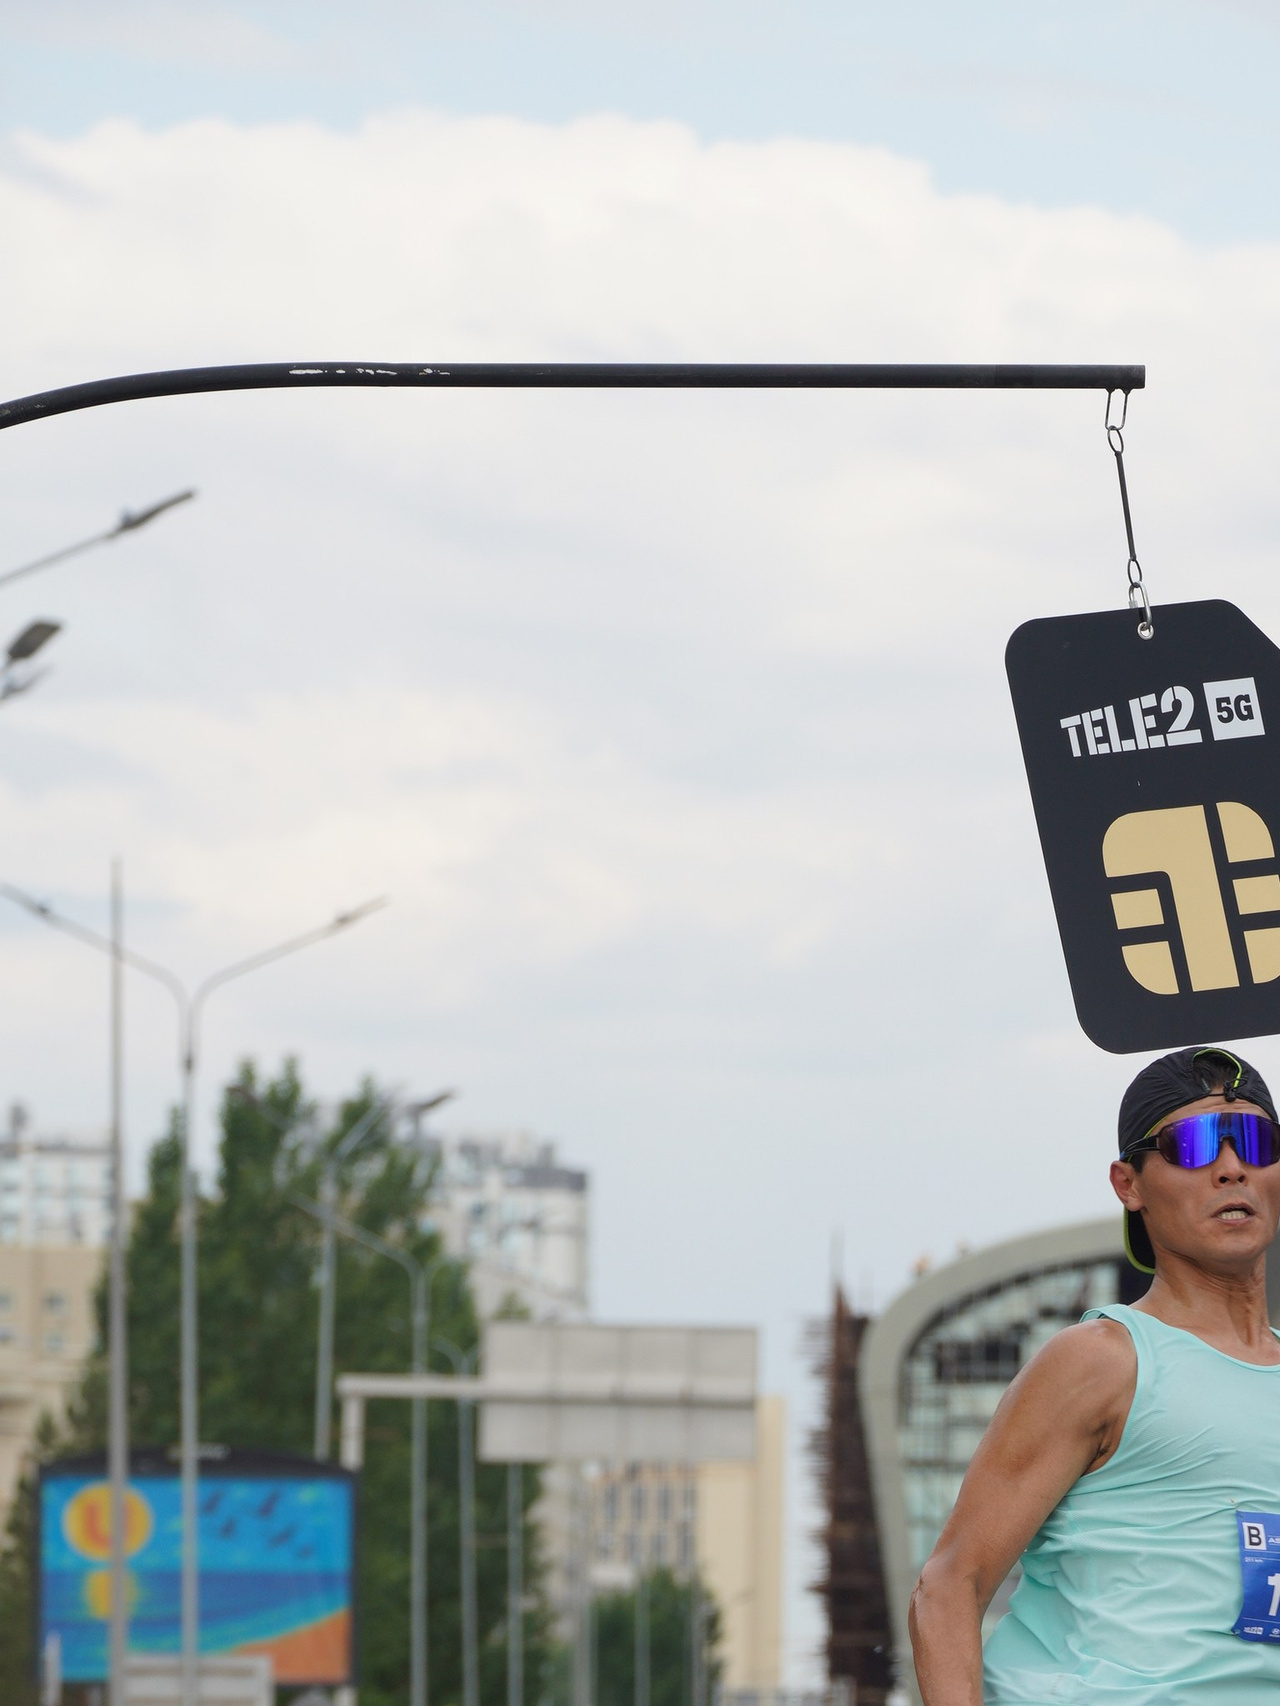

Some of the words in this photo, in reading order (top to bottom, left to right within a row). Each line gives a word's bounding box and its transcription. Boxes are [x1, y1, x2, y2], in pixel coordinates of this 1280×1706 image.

[1060, 686, 1203, 757] TELE2
[1215, 694, 1255, 724] 5G
[1247, 1525, 1263, 1547] B
